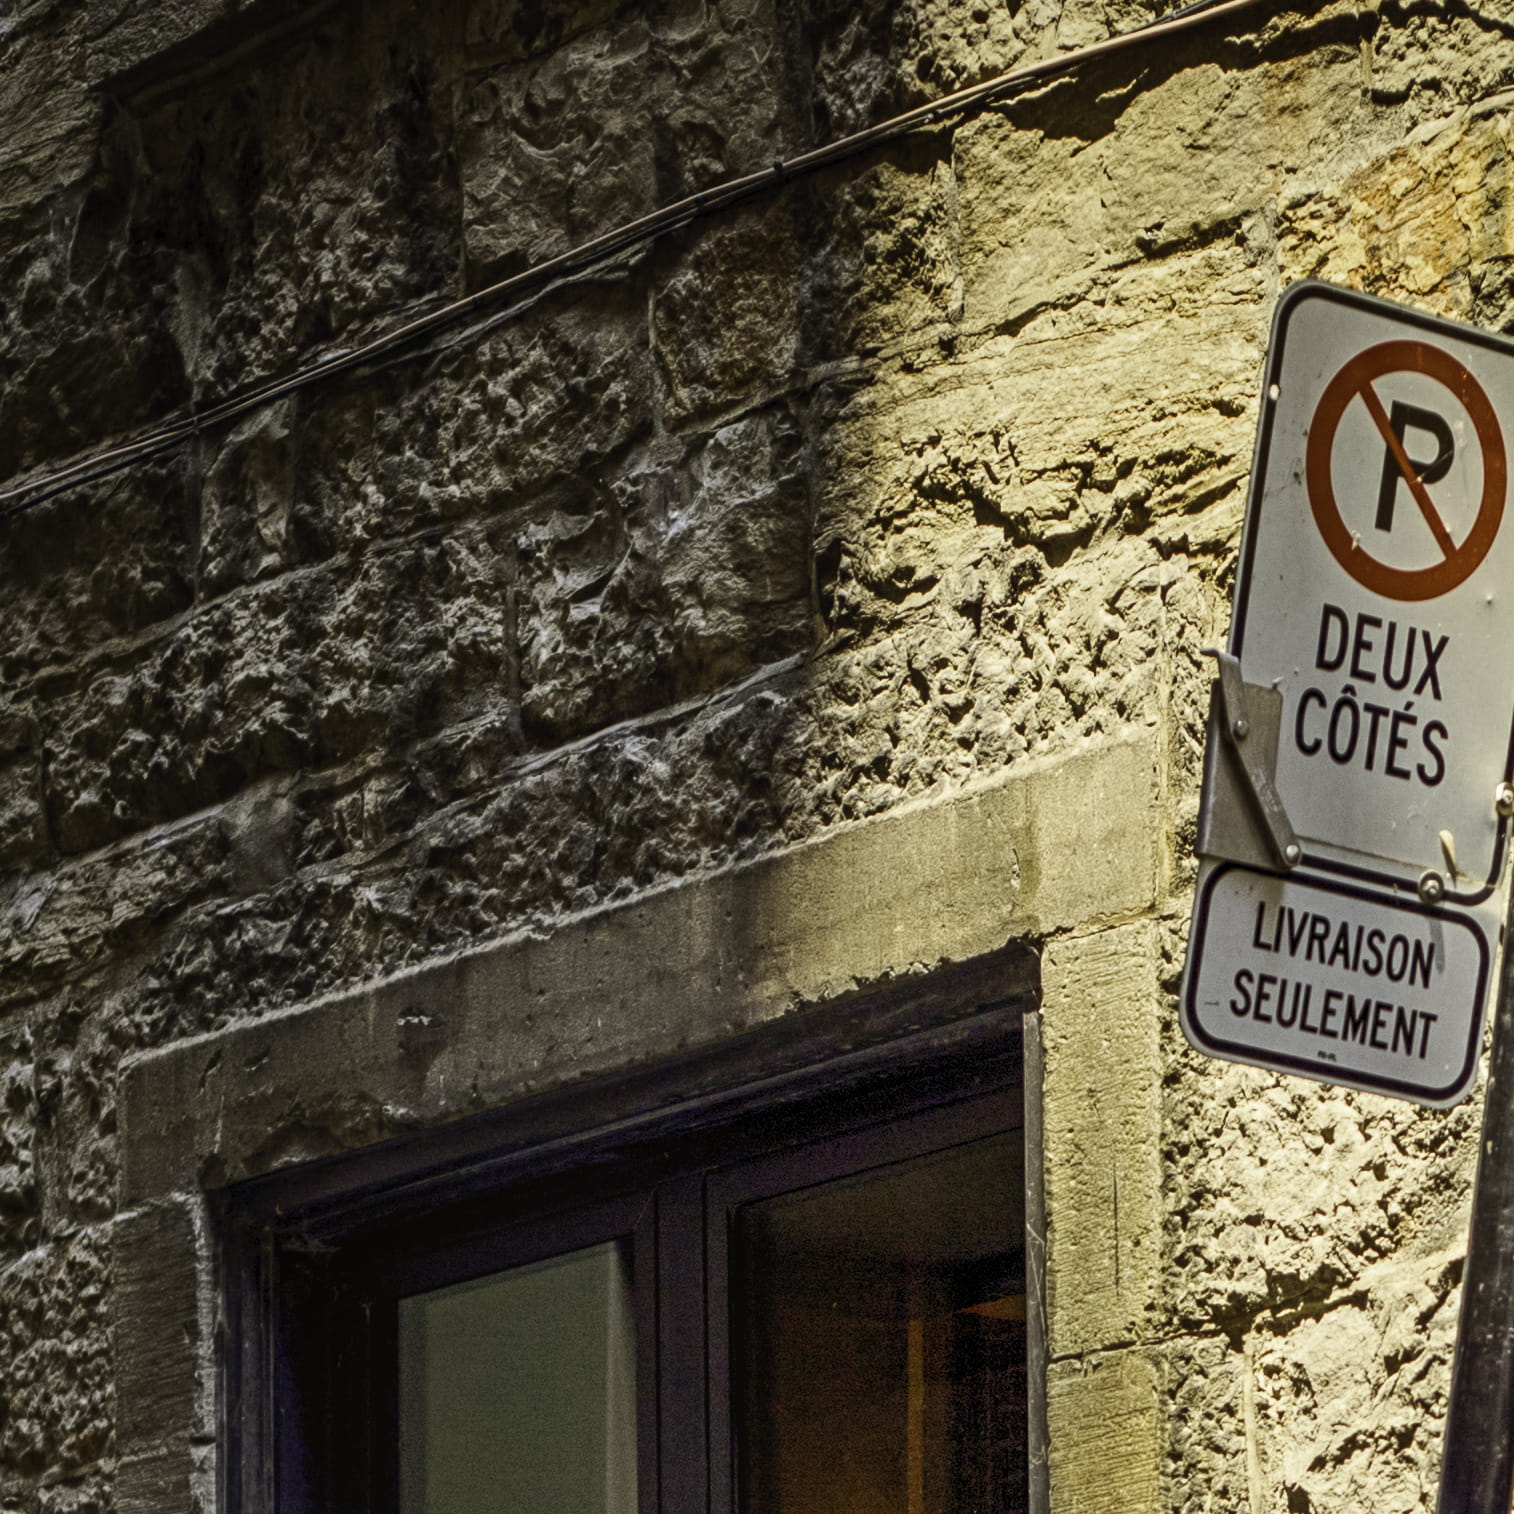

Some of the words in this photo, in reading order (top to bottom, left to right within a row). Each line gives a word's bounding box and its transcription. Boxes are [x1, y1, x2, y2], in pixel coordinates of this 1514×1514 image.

[1374, 399, 1456, 533] P
[1315, 603, 1451, 702] DEUX
[1294, 685, 1450, 788] CÔTÉS
[1252, 899, 1436, 991] LIVRAISON
[1229, 968, 1439, 1061] SEULEMENT
